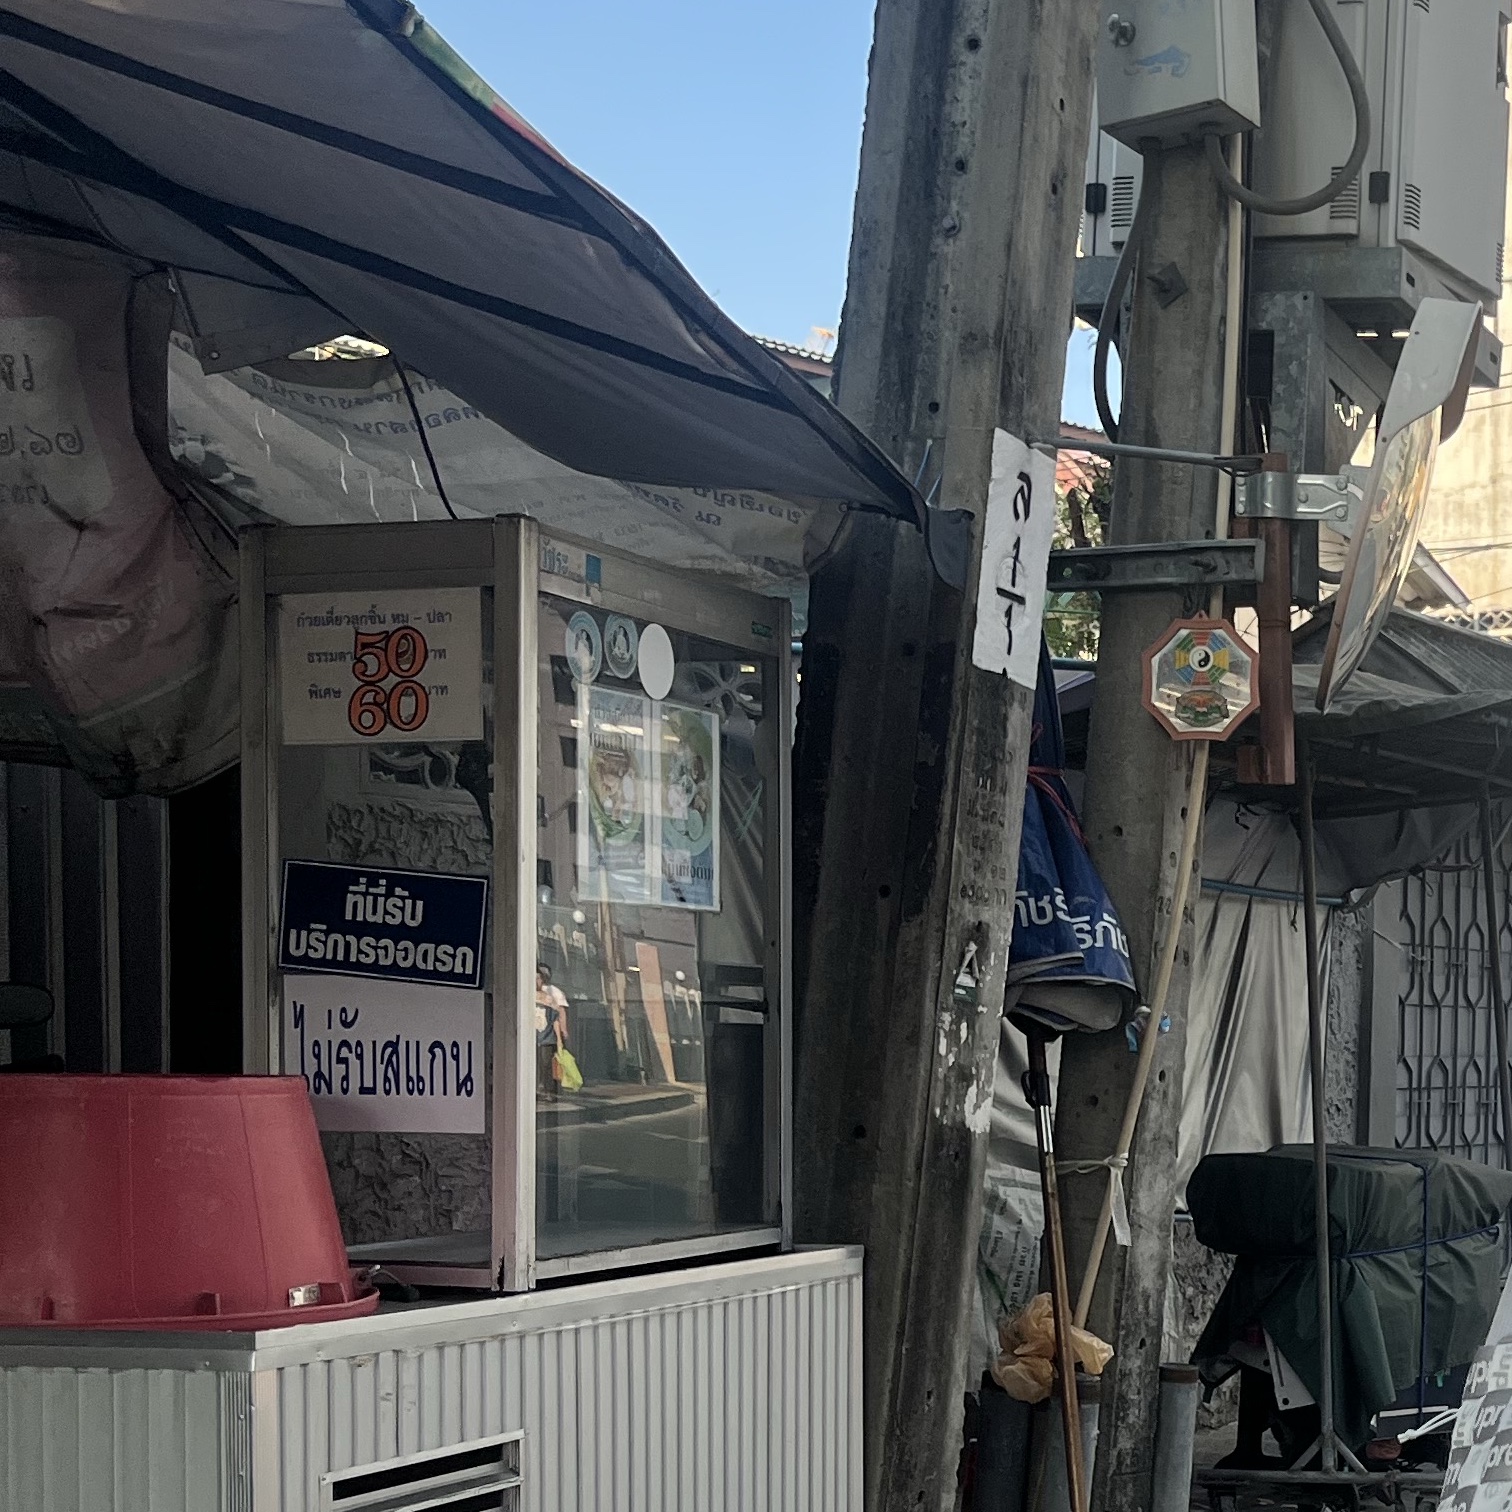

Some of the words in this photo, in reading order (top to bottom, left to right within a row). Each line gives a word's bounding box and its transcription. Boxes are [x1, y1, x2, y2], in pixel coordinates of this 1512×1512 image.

[426, 608, 453, 624] ปลา
[352, 626, 428, 684] 50
[308, 683, 342, 700] พิเศษ
[348, 679, 429, 737] 60
[345, 877, 424, 927] ที่นี่รับ
[289, 923, 474, 975] บริการจอดรถ
[292, 1000, 474, 1098] ไม่รับสแกน
